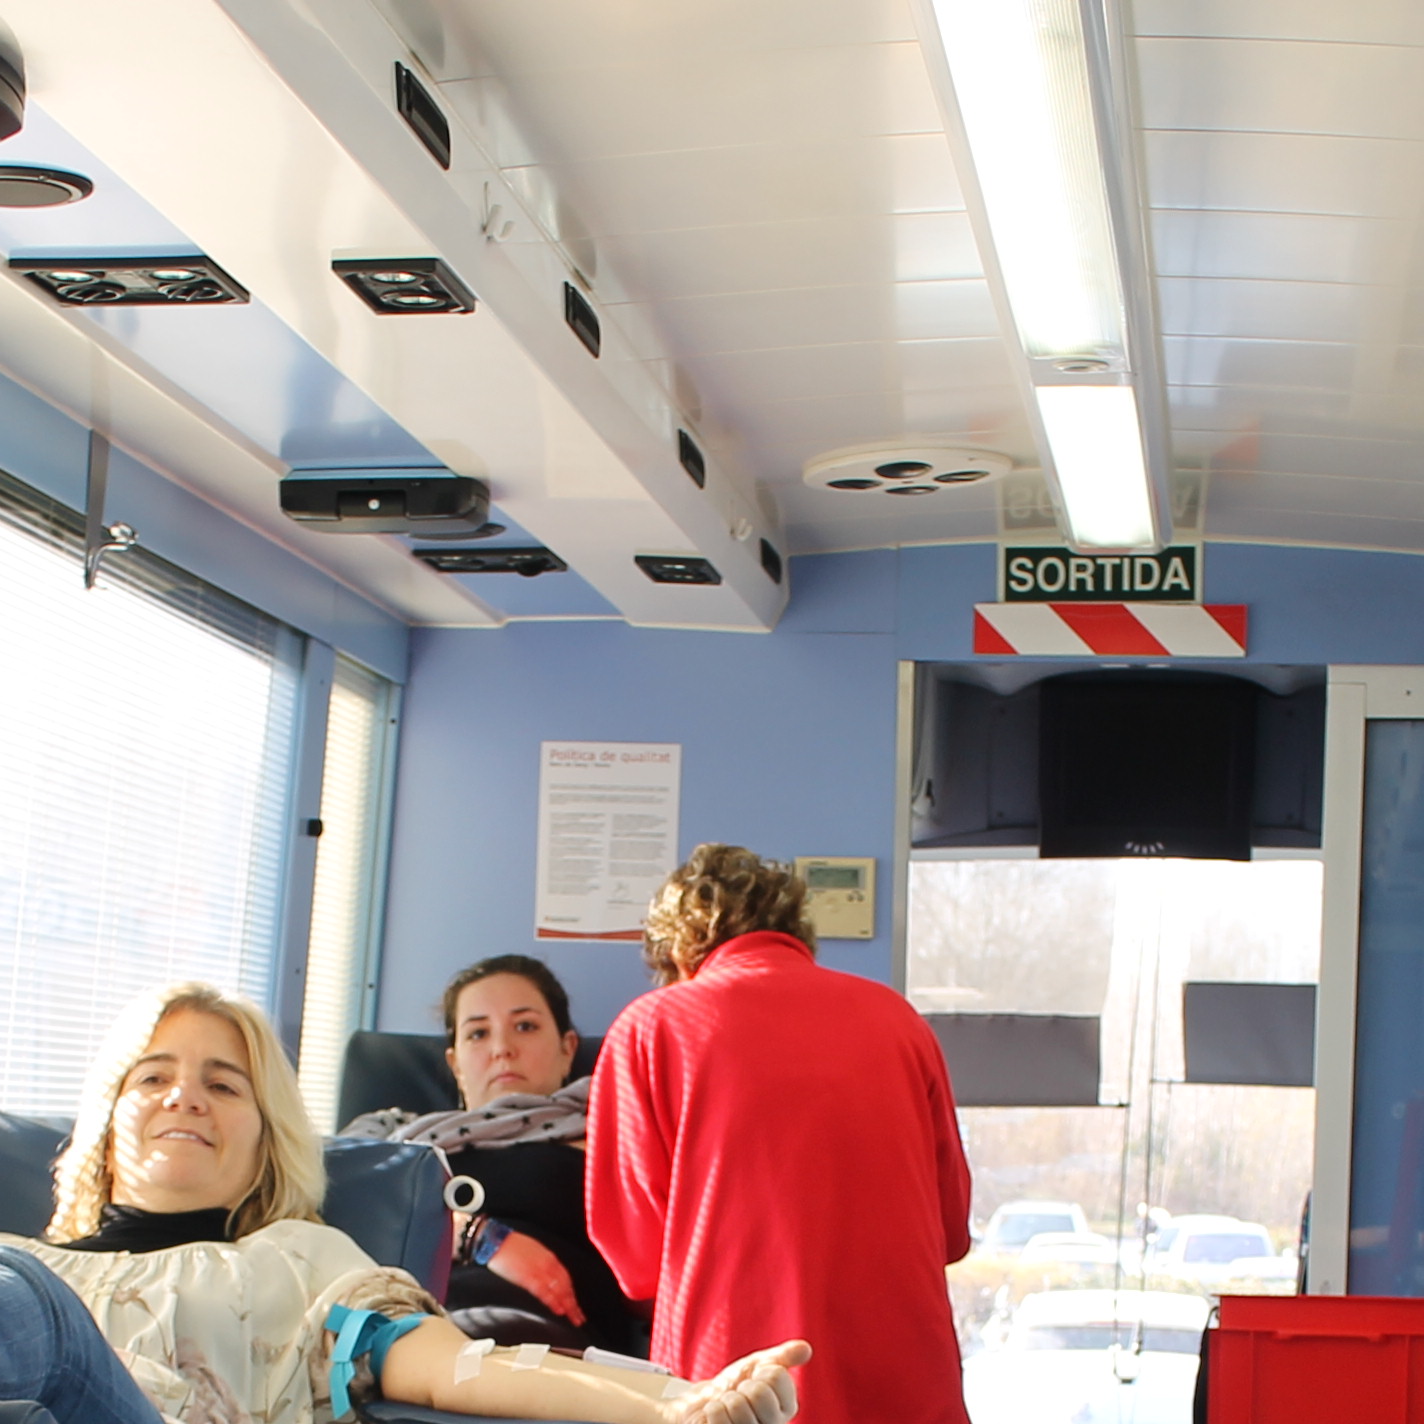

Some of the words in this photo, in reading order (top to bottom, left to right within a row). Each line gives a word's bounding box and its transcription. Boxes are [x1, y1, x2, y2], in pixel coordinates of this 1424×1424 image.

[1008, 556, 1191, 593] SORTIDA
[600, 751, 616, 761] de
[621, 752, 671, 763] qualitat
